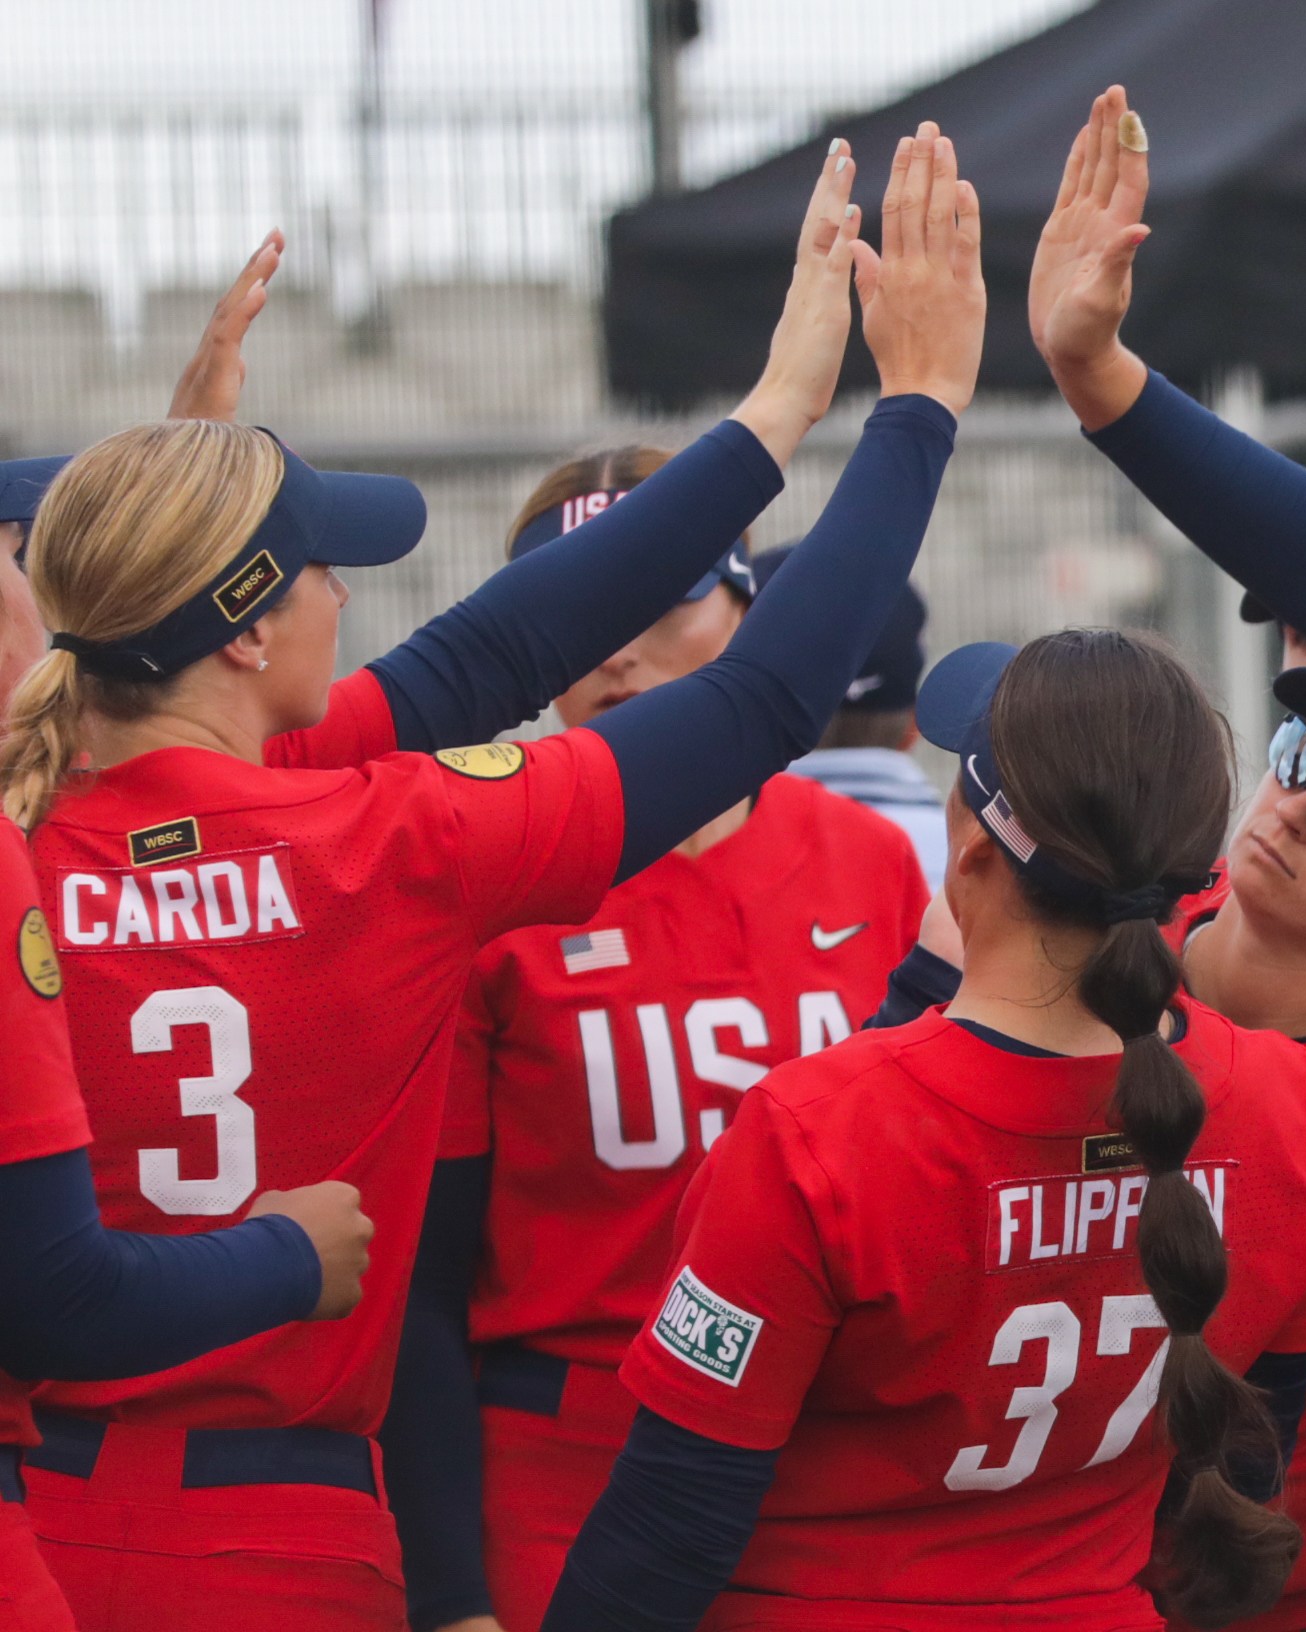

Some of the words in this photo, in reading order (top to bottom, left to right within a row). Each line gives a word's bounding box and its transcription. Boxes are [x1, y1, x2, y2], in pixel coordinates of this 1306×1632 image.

[562, 490, 629, 536] US
[231, 567, 265, 600] WBSC
[144, 830, 183, 849] WBSC
[62, 855, 299, 945] CARDA
[130, 986, 257, 1216] 3
[1098, 1142, 1134, 1158] WBSC
[999, 1168, 1225, 1266] FLIPPN
[662, 1284, 744, 1363] DICK'S
[690, 1283, 714, 1305] SEASON
[713, 1302, 743, 1324] STARTS
[743, 1318, 757, 1329] AT
[659, 1320, 692, 1353] SPORTING
[693, 1348, 731, 1374] GOODS
[943, 1294, 1171, 1491] 37
